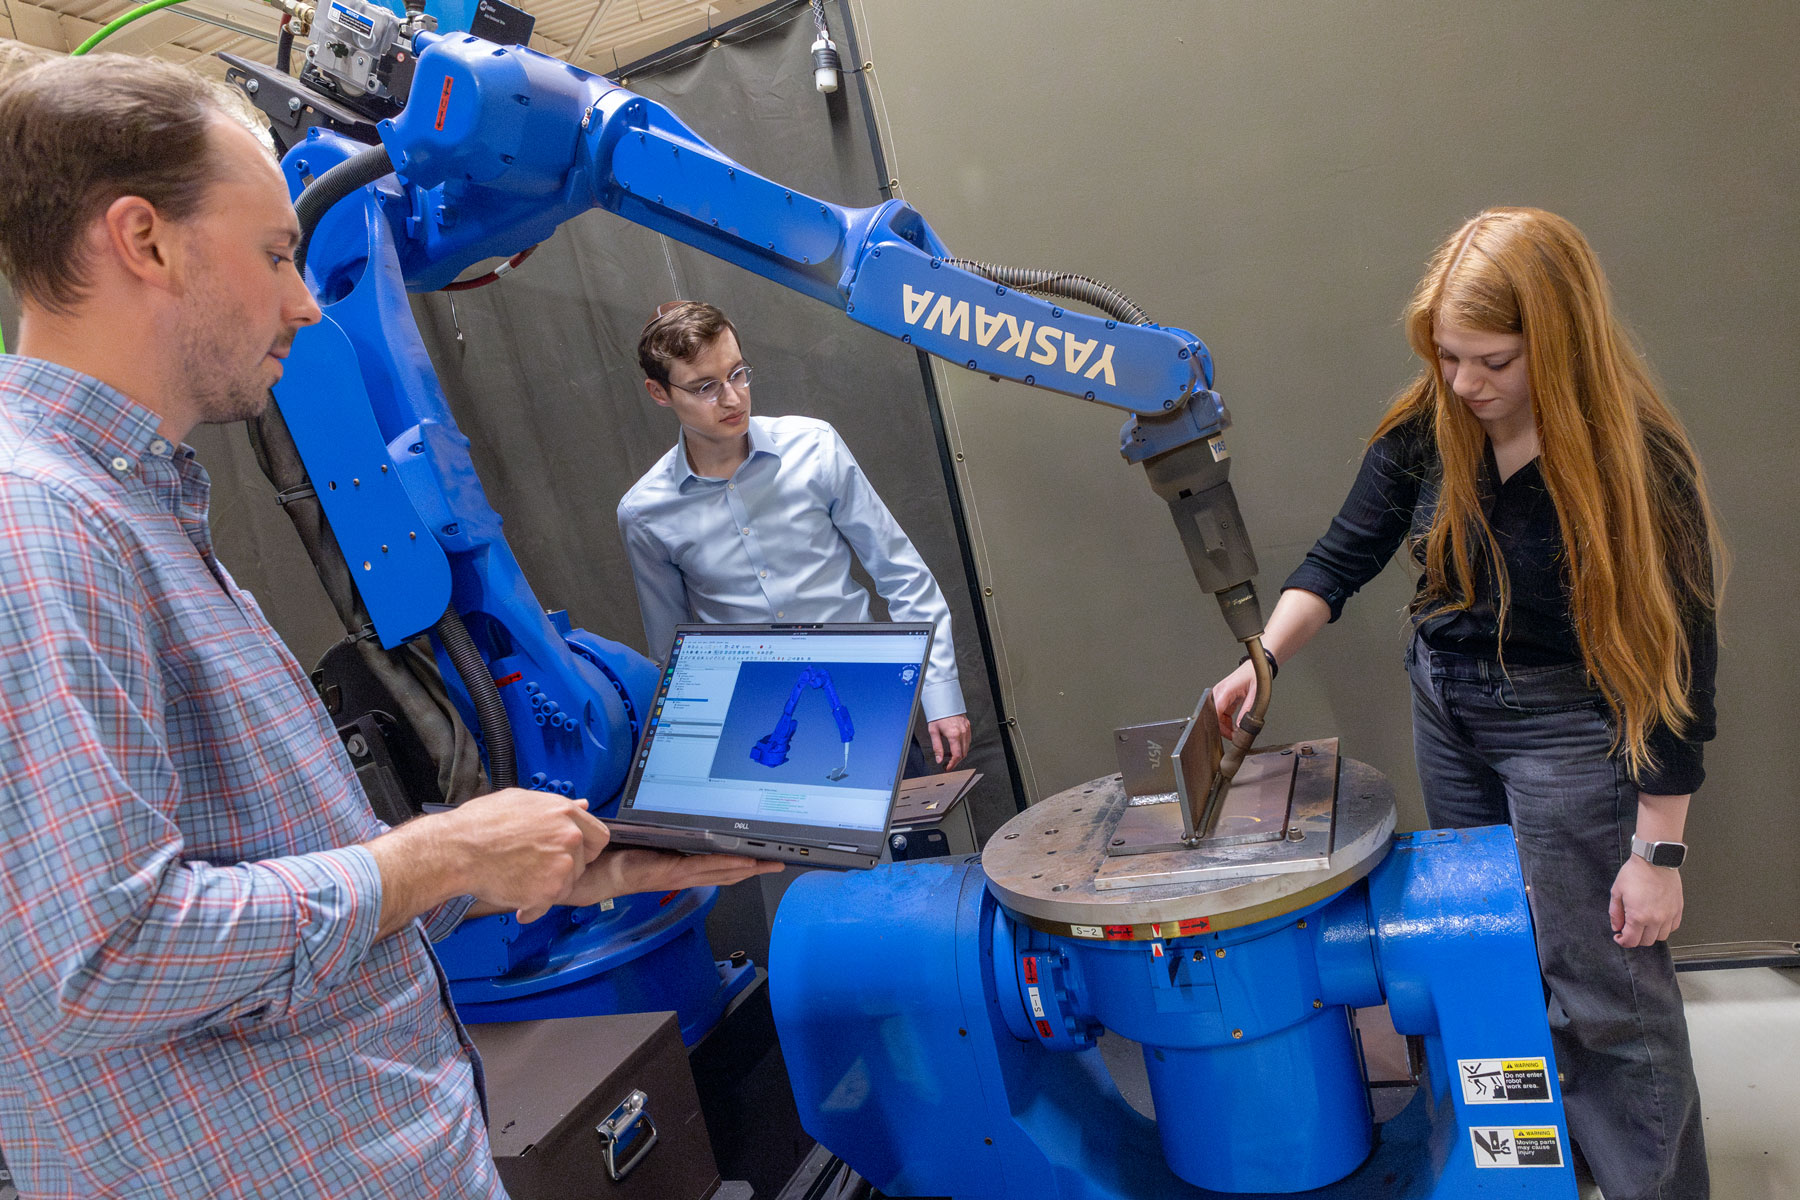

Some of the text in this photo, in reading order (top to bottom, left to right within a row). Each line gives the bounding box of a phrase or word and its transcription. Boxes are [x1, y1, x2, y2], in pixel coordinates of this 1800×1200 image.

[903, 284, 1116, 386] YASKAWA
[734, 822, 749, 830] DELL
[1076, 926, 1098, 936] S-2
[1031, 994, 1042, 1012] S-1
